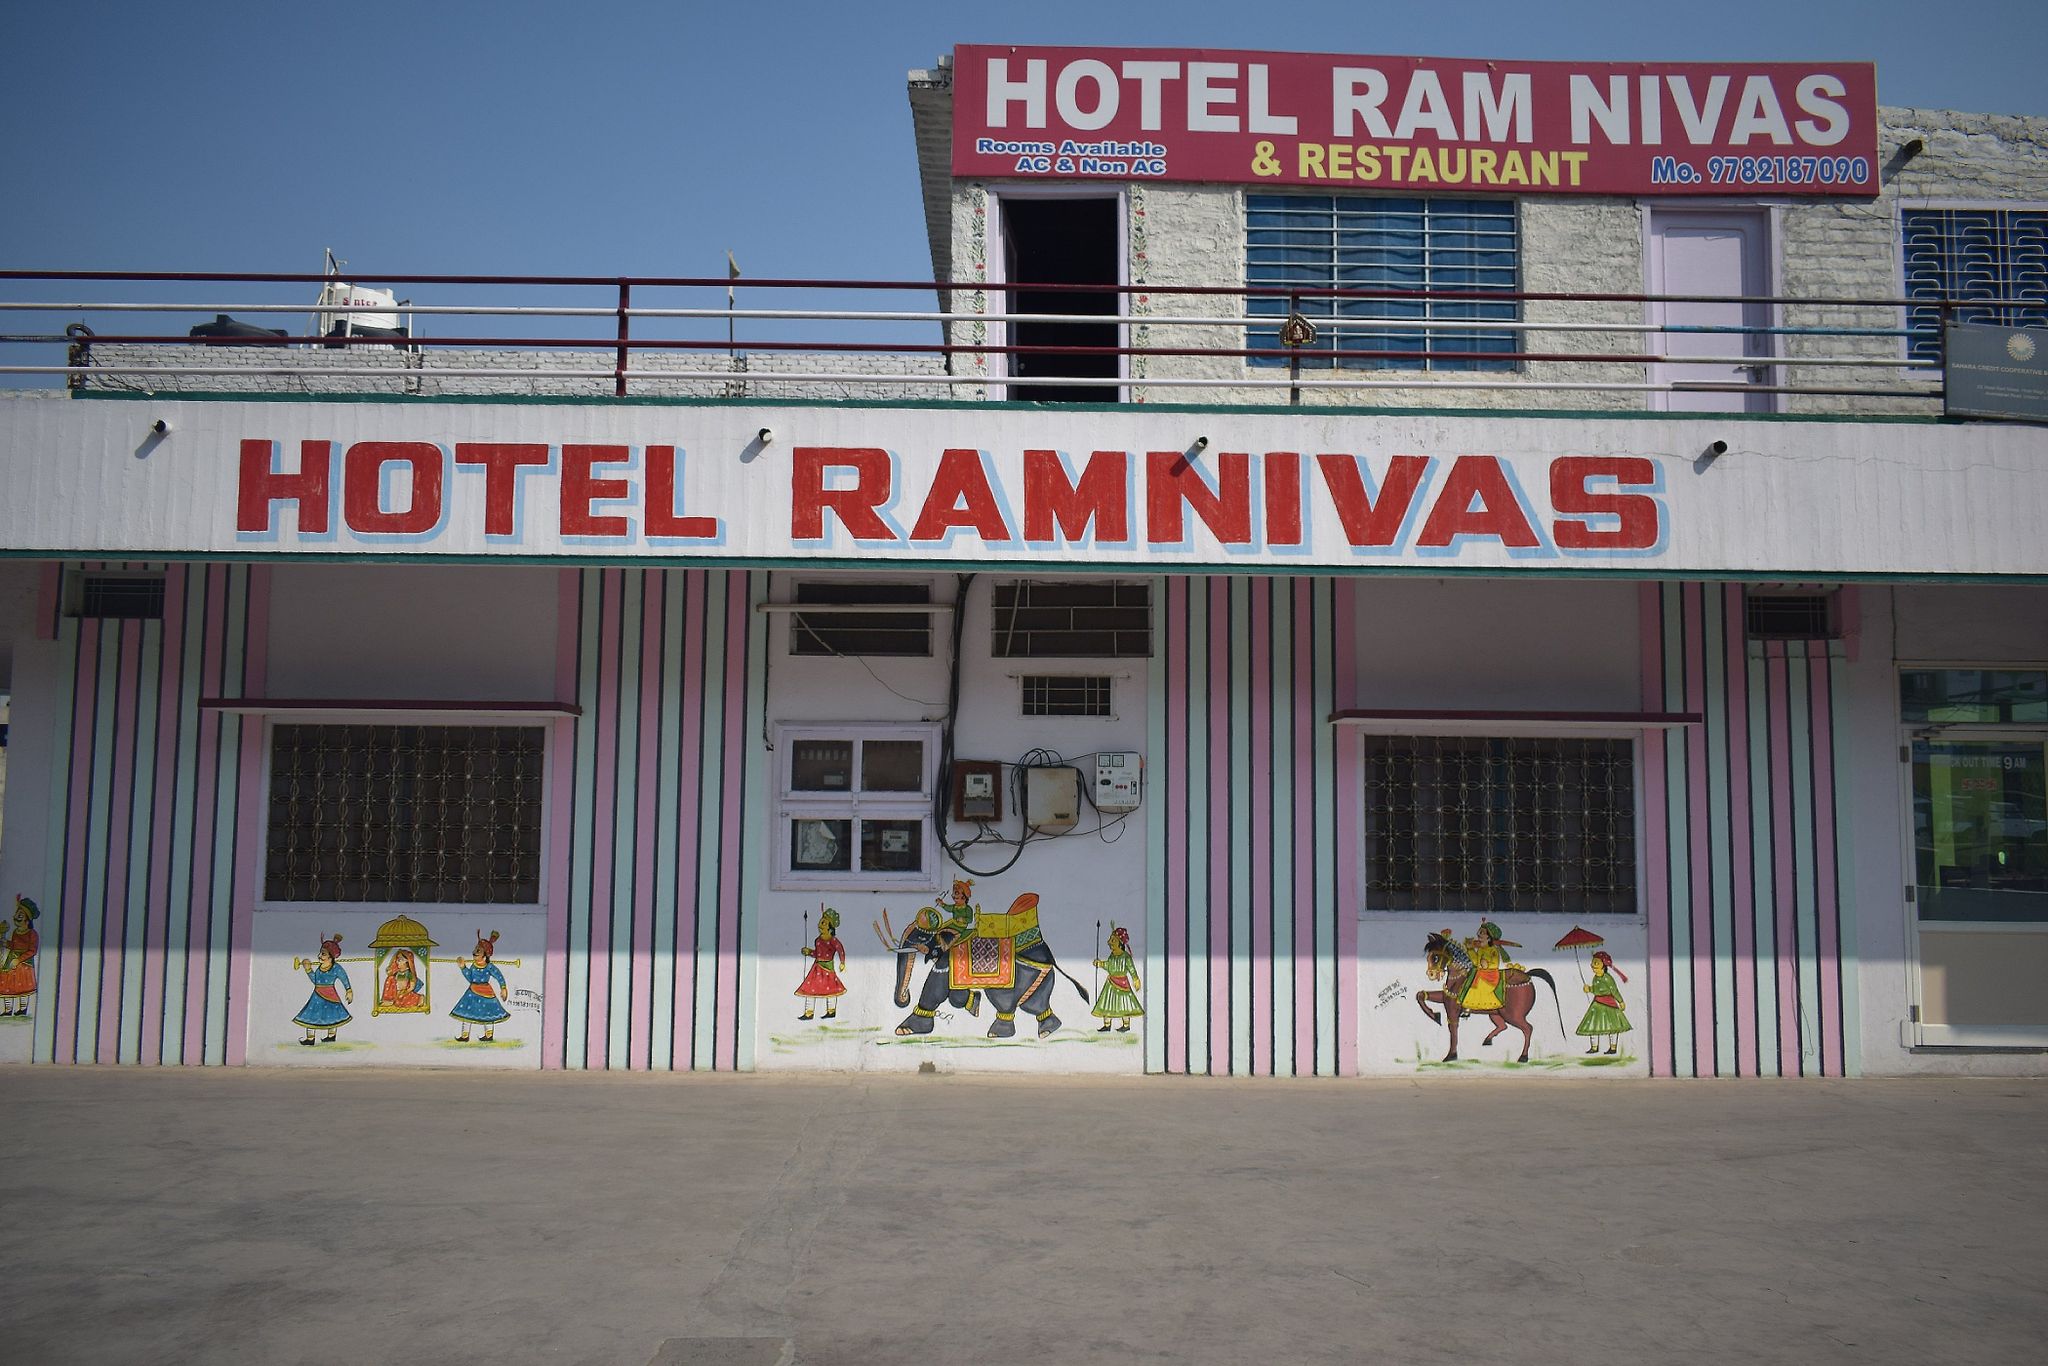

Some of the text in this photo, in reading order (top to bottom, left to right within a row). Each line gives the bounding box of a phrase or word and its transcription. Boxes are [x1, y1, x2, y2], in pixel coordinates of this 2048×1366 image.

[986, 58, 1850, 146] HOTEL RAM NIVAS
[976, 137, 1167, 157] Rooms Available
[1014, 156, 1167, 176] AC & Non AC
[1251, 140, 1589, 187] & RESTAURANT
[1651, 156, 1869, 184] Mo. 9782187090
[236, 438, 725, 547] HOTEL
[1963, 757, 1979, 768] OUT
[1981, 757, 2001, 768] TIME
[2003, 756, 2013, 770] 9
[2014, 757, 2026, 768] AM
